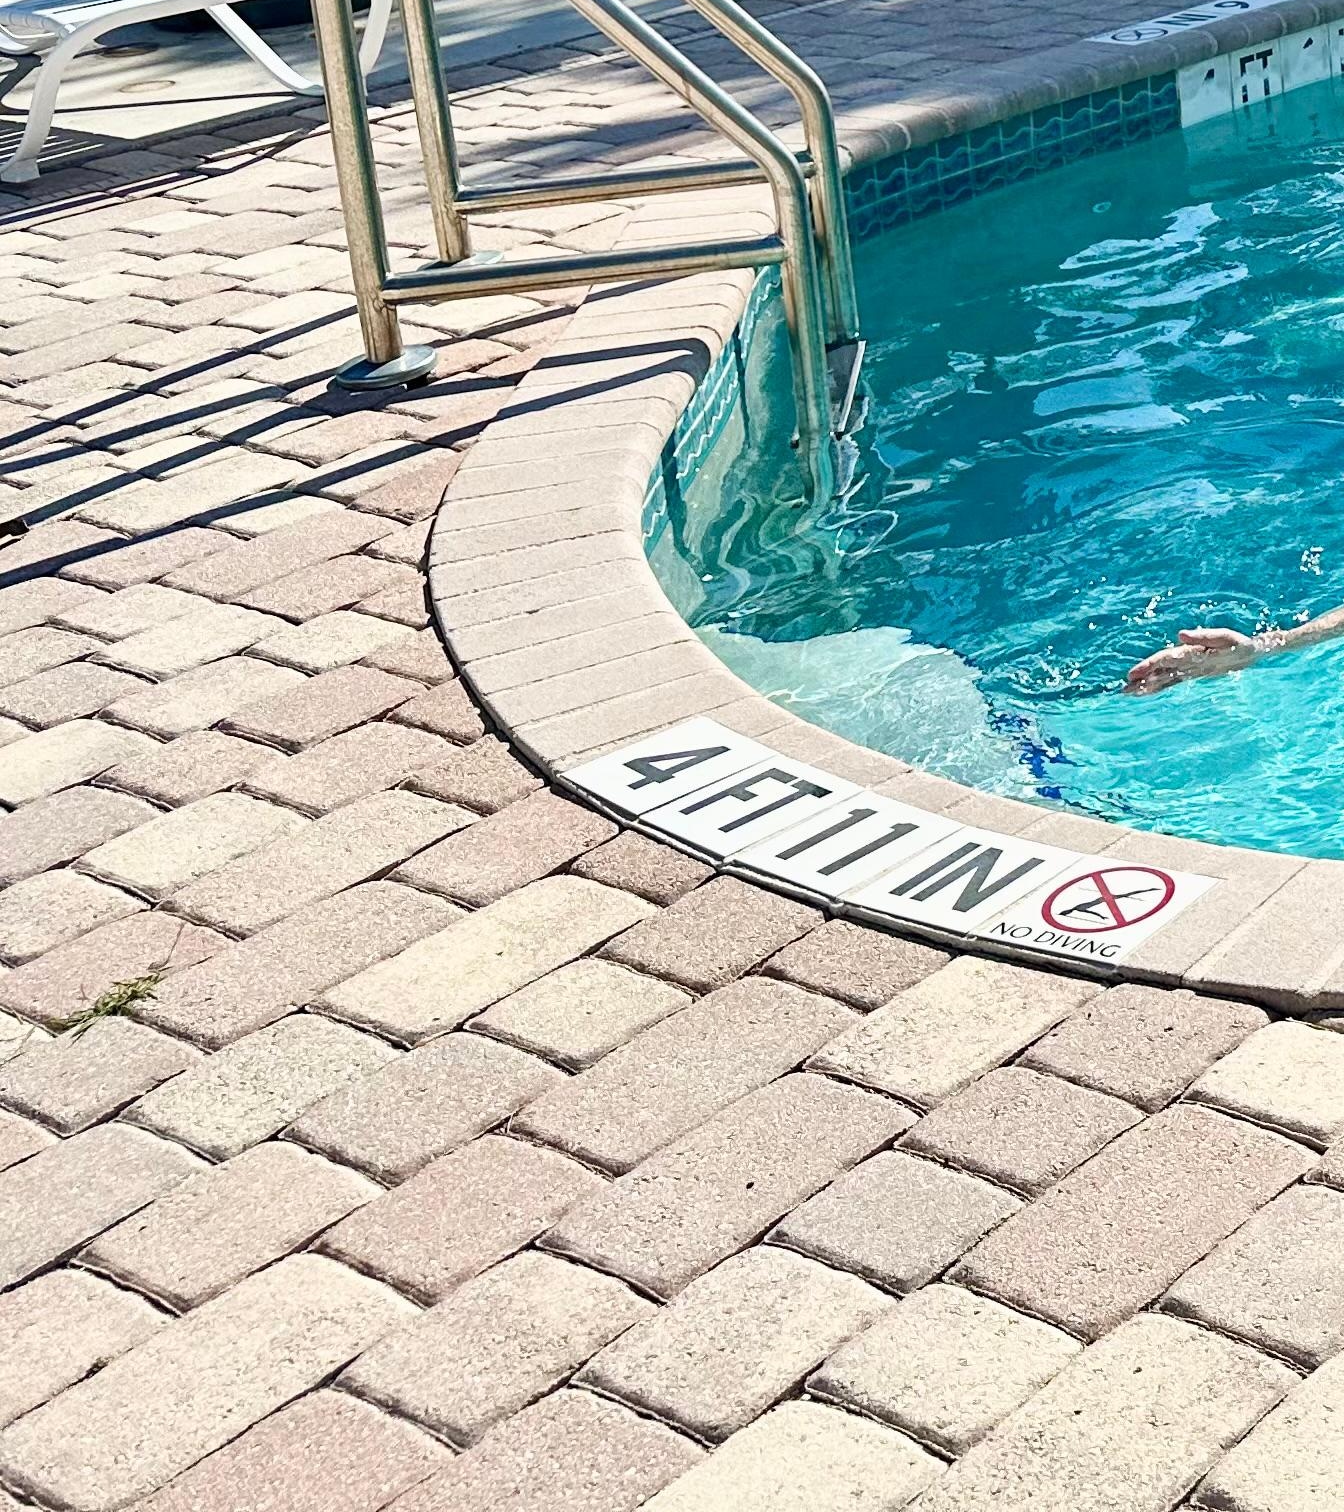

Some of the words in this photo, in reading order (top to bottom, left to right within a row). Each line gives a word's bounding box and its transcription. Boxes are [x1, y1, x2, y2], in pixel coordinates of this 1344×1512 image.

[1156, 13, 1217, 26] IN
[623, 746, 731, 789] 4
[678, 767, 833, 833] FT
[775, 808, 919, 876] 11
[889, 842, 1046, 913] IN
[990, 922, 1033, 939] NO
[1032, 930, 1122, 958] DIVING
